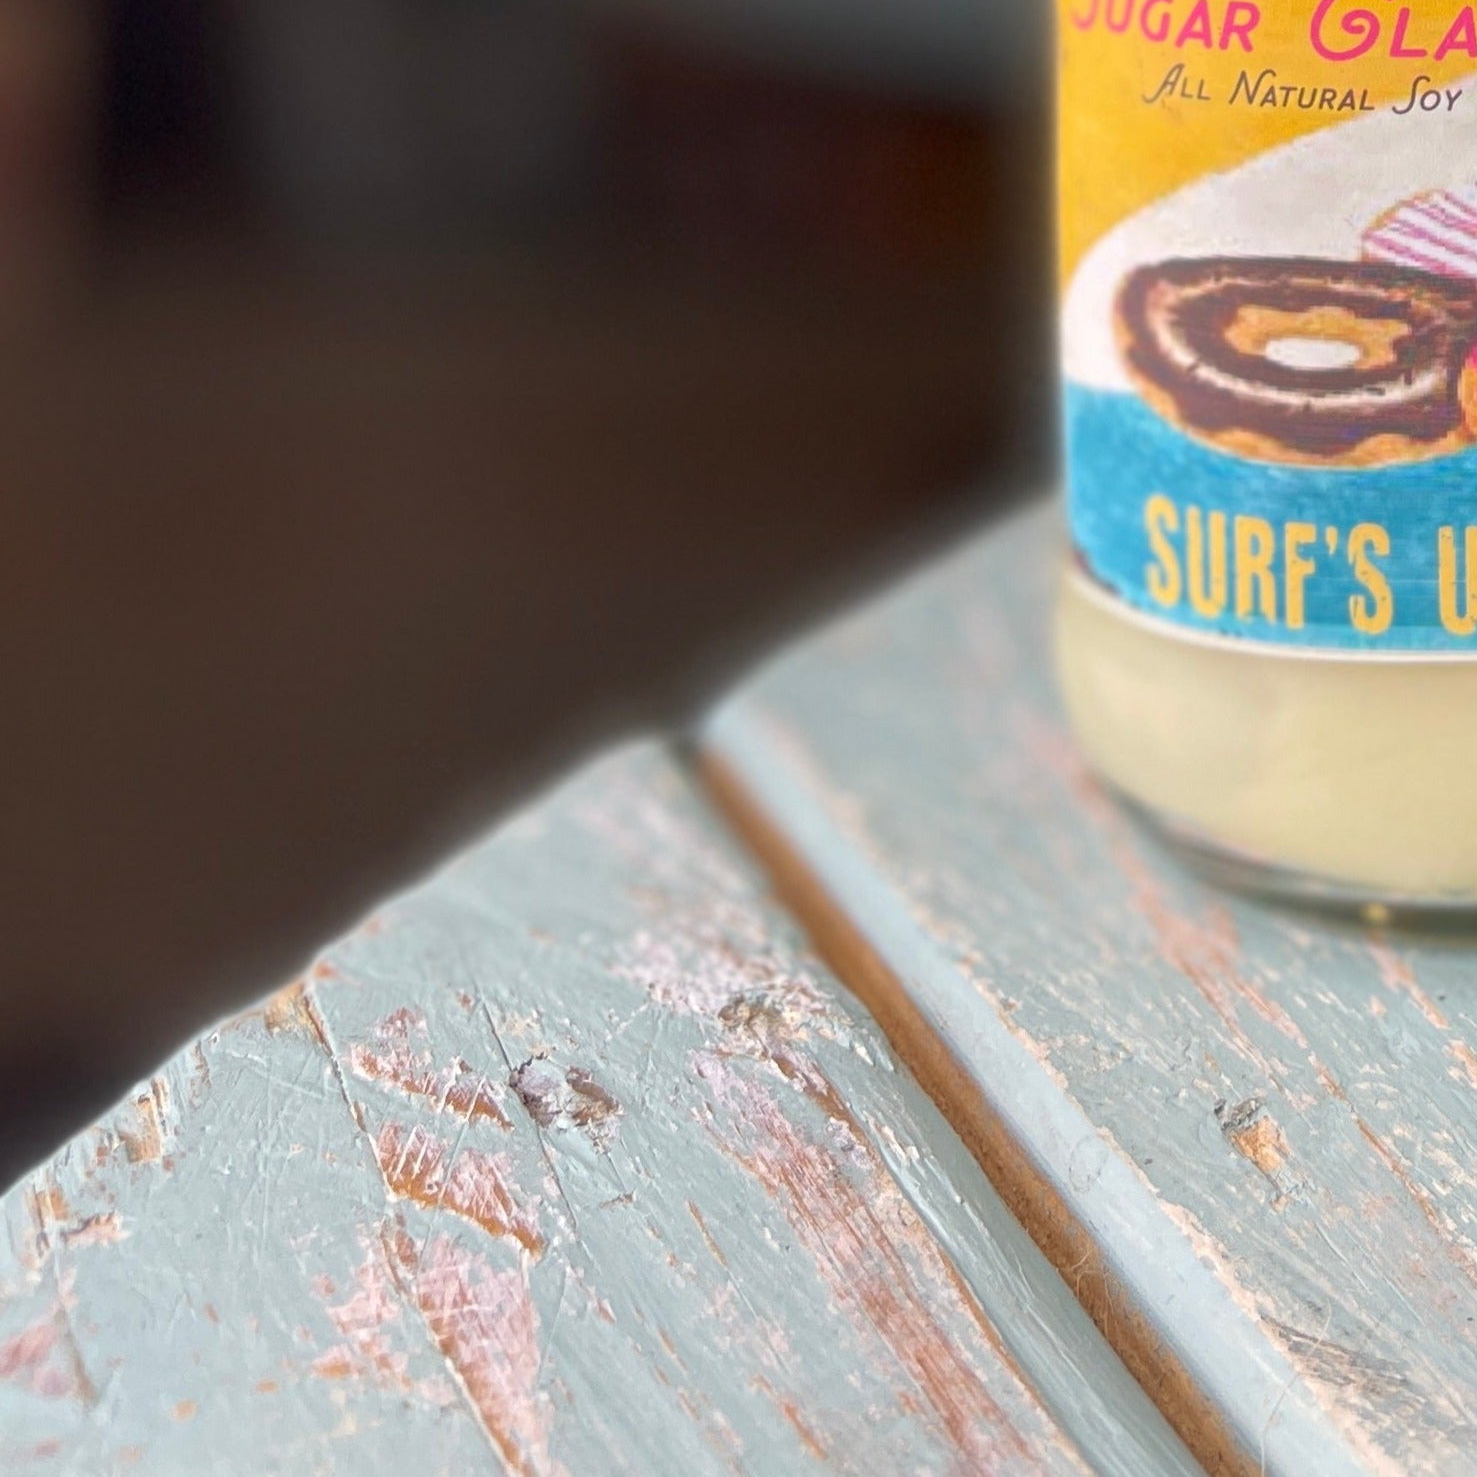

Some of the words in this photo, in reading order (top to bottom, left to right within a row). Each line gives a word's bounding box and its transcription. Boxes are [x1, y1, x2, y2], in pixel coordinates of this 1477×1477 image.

[1142, 62, 1211, 104] ALL
[1228, 69, 1375, 112] NATURAL
[1391, 74, 1463, 115] SOY
[1143, 494, 1395, 636] SURF'S
